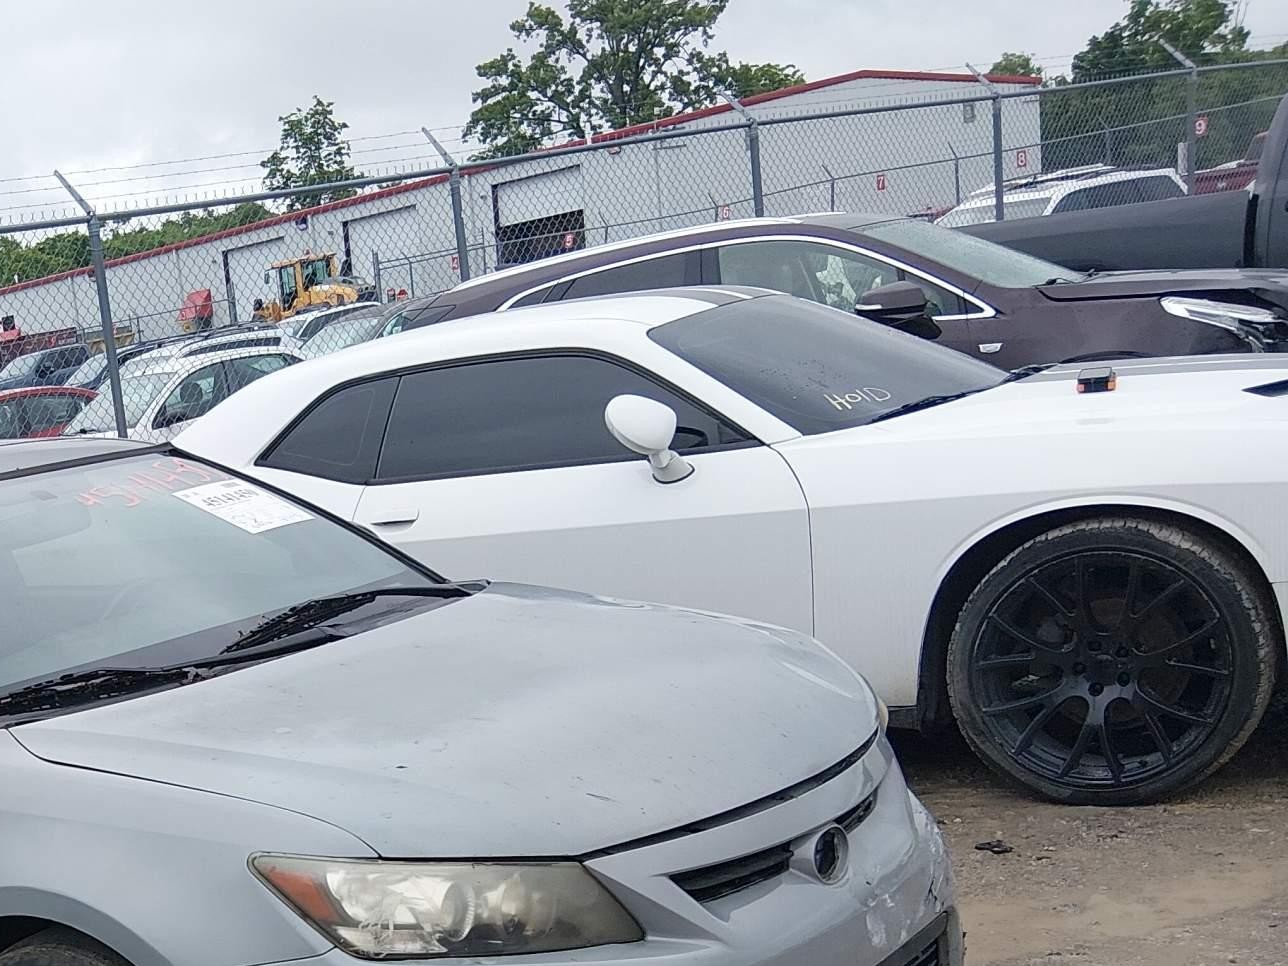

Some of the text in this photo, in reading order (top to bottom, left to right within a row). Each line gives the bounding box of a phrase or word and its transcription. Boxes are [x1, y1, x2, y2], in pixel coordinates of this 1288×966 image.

[1195, 119, 1205, 135] 9
[1018, 152, 1026, 166] 8
[877, 176, 883, 188] 7
[723, 206, 730, 219] 6
